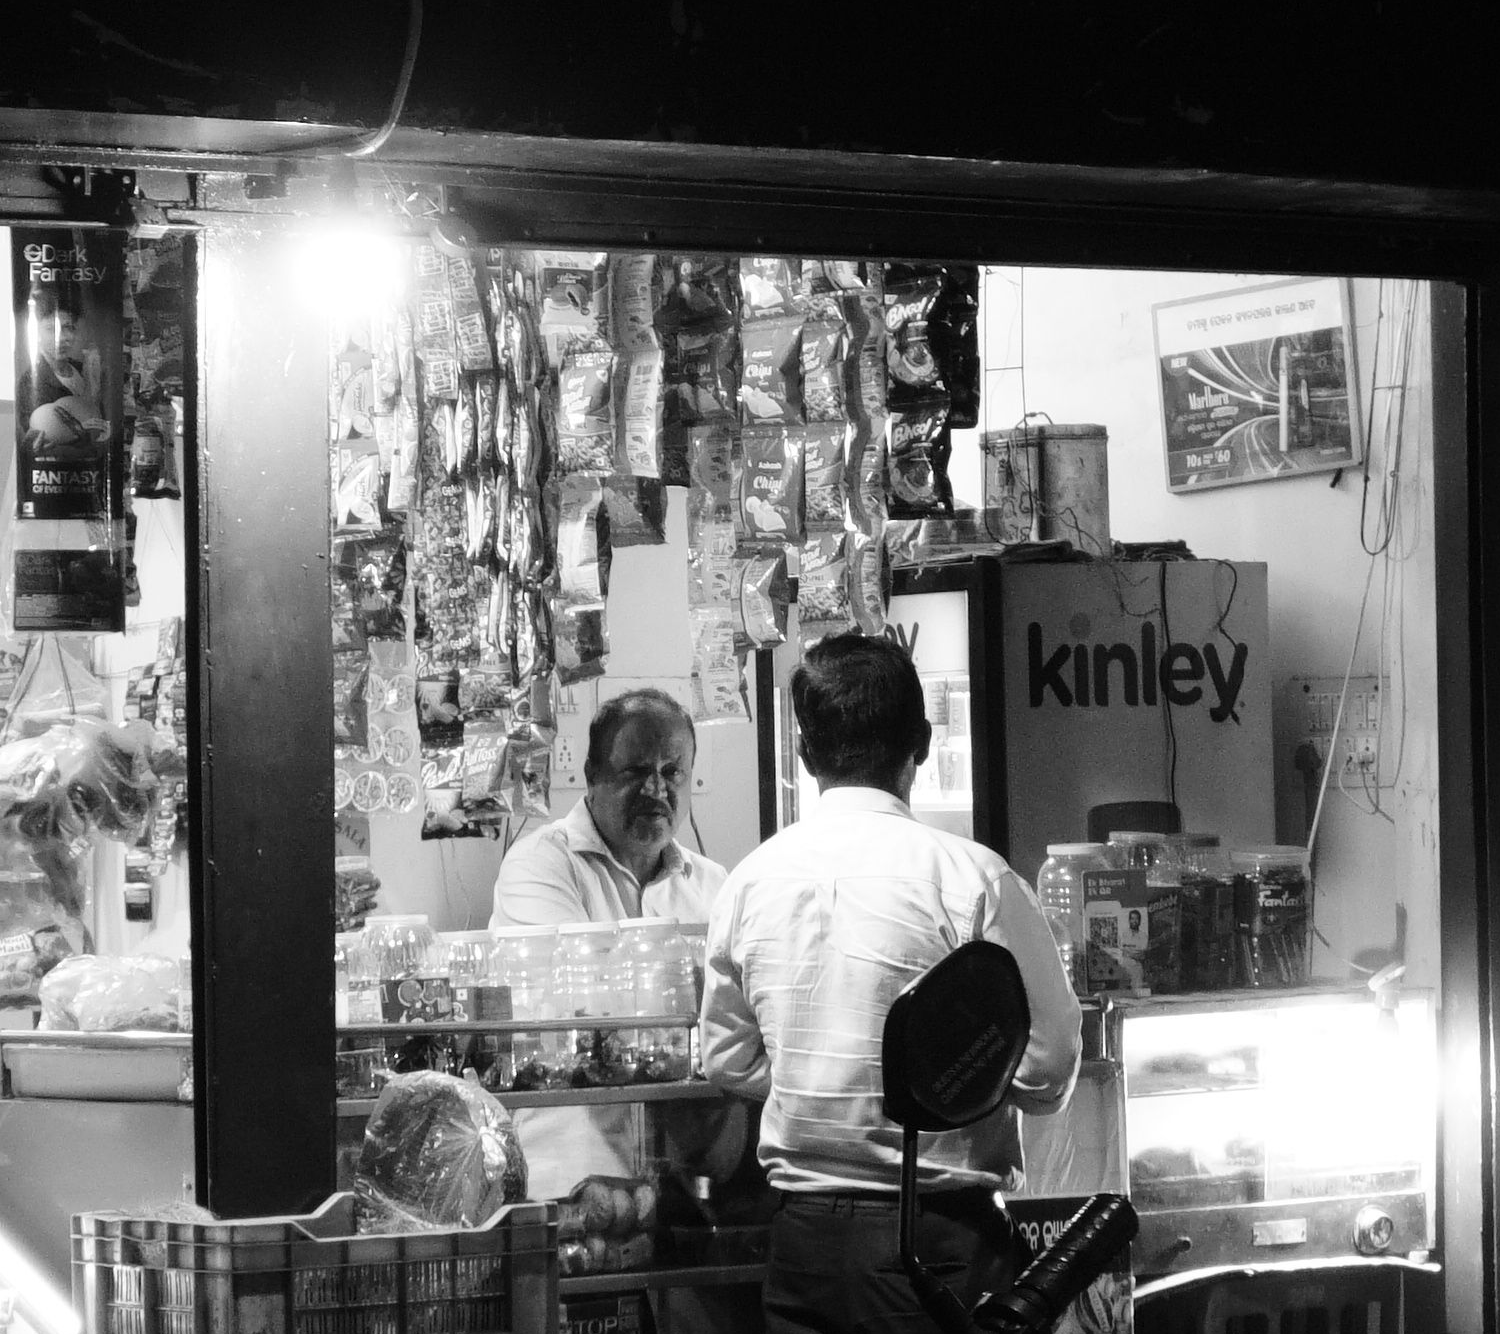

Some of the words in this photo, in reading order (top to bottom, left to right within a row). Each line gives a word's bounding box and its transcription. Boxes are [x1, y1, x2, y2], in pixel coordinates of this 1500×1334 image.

[42, 244, 88, 263] Dark
[28, 261, 107, 284] Fantasy
[1028, 611, 1249, 726] kinley
